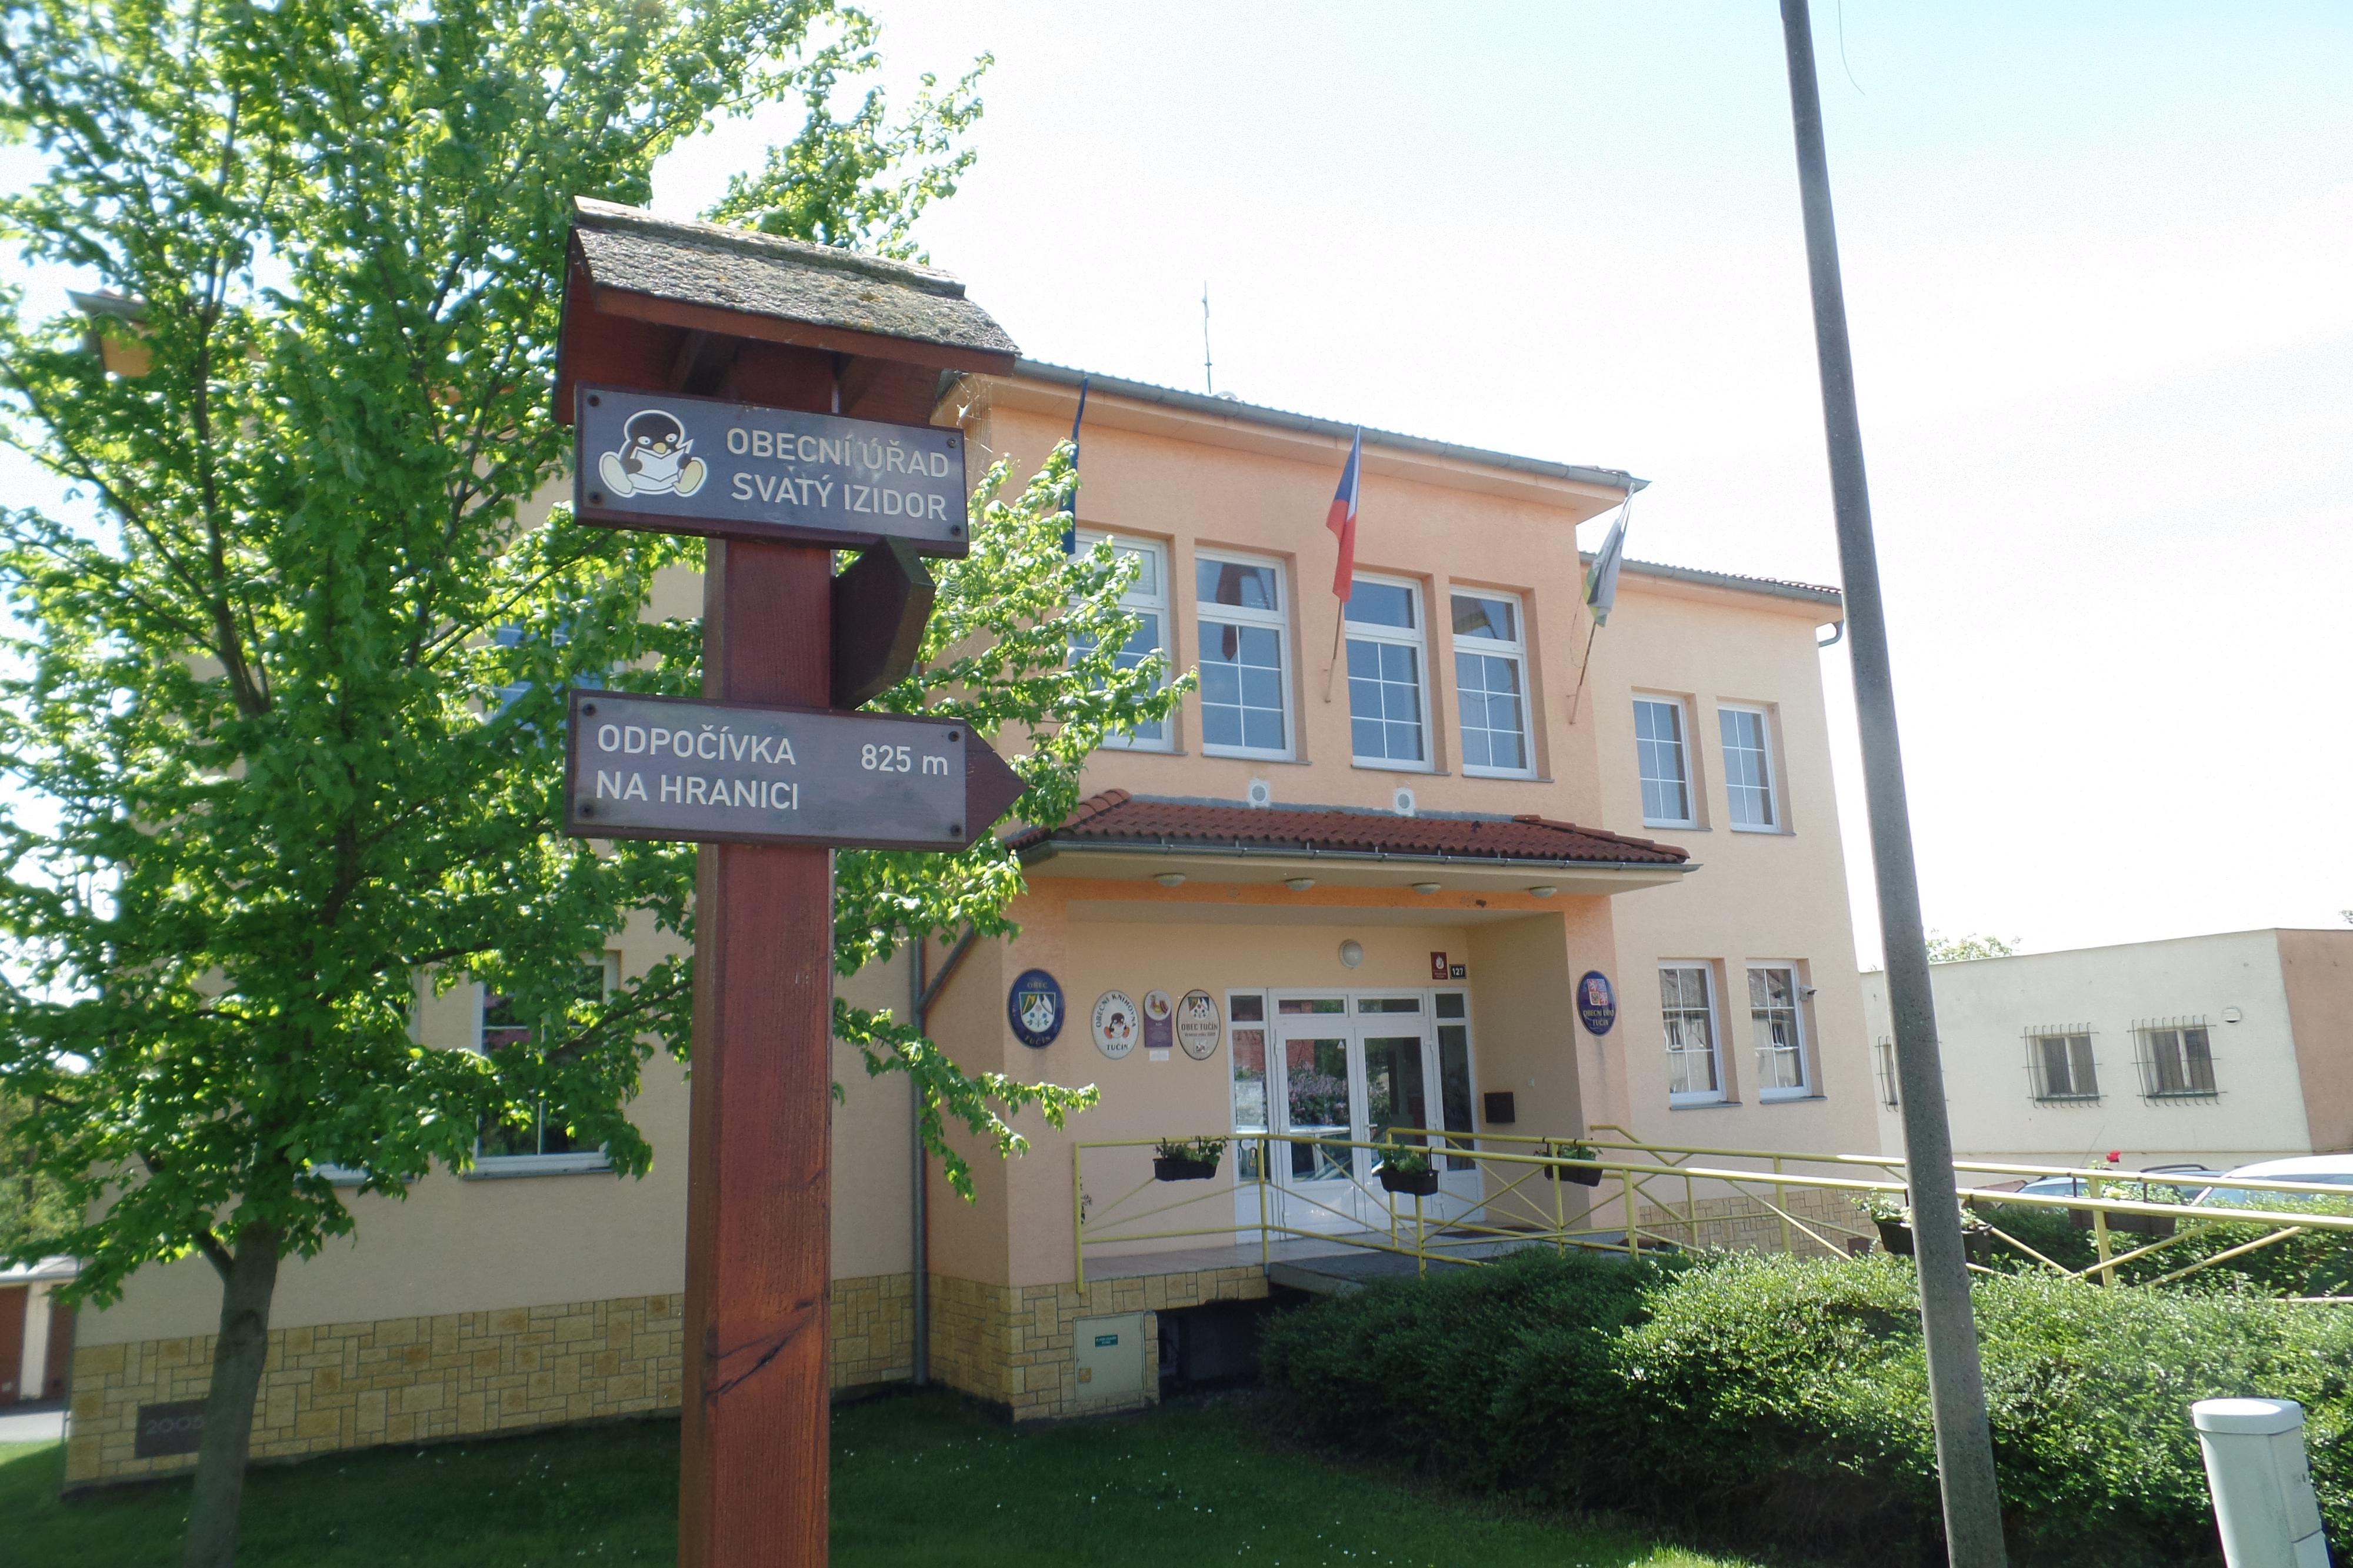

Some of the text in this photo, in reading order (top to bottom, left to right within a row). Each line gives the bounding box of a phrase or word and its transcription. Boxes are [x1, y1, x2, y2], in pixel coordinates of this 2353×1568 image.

[727, 428, 948, 478] OBECNÍ ÚŘAD
[731, 472, 947, 521] SVATÝ IZIDOR
[598, 724, 796, 765] ODPOČÍVKA
[861, 743, 948, 775] 825 m
[596, 770, 798, 810] NA HRANICI
[1452, 968, 1464, 976] 127
[1112, 993, 1136, 1027] KNIHOVNA
[1201, 1022, 1218, 1031] TUČÍN
[1107, 1043, 1128, 1051] TUČÍN
